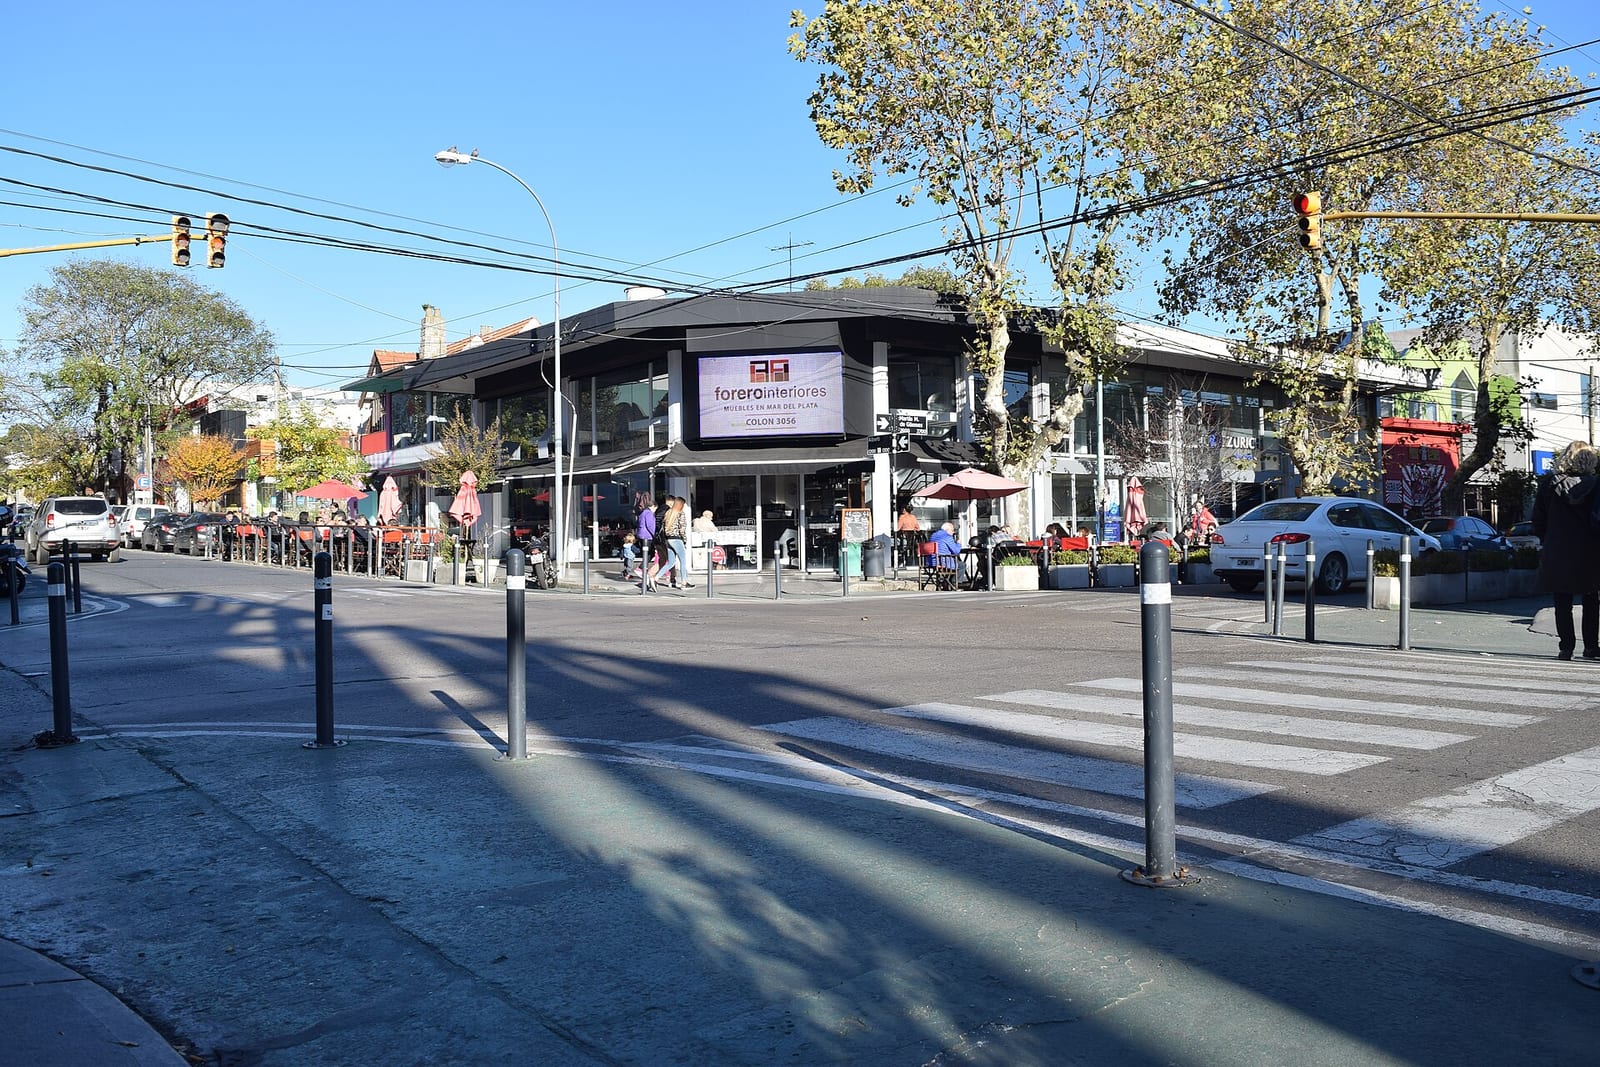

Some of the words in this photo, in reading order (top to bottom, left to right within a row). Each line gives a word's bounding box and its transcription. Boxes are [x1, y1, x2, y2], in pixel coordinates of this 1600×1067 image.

[714, 386, 827, 401] forerointeriores
[746, 418, 774, 426] COLON
[777, 417, 797, 425] 3056
[141, 478, 149, 487] E
